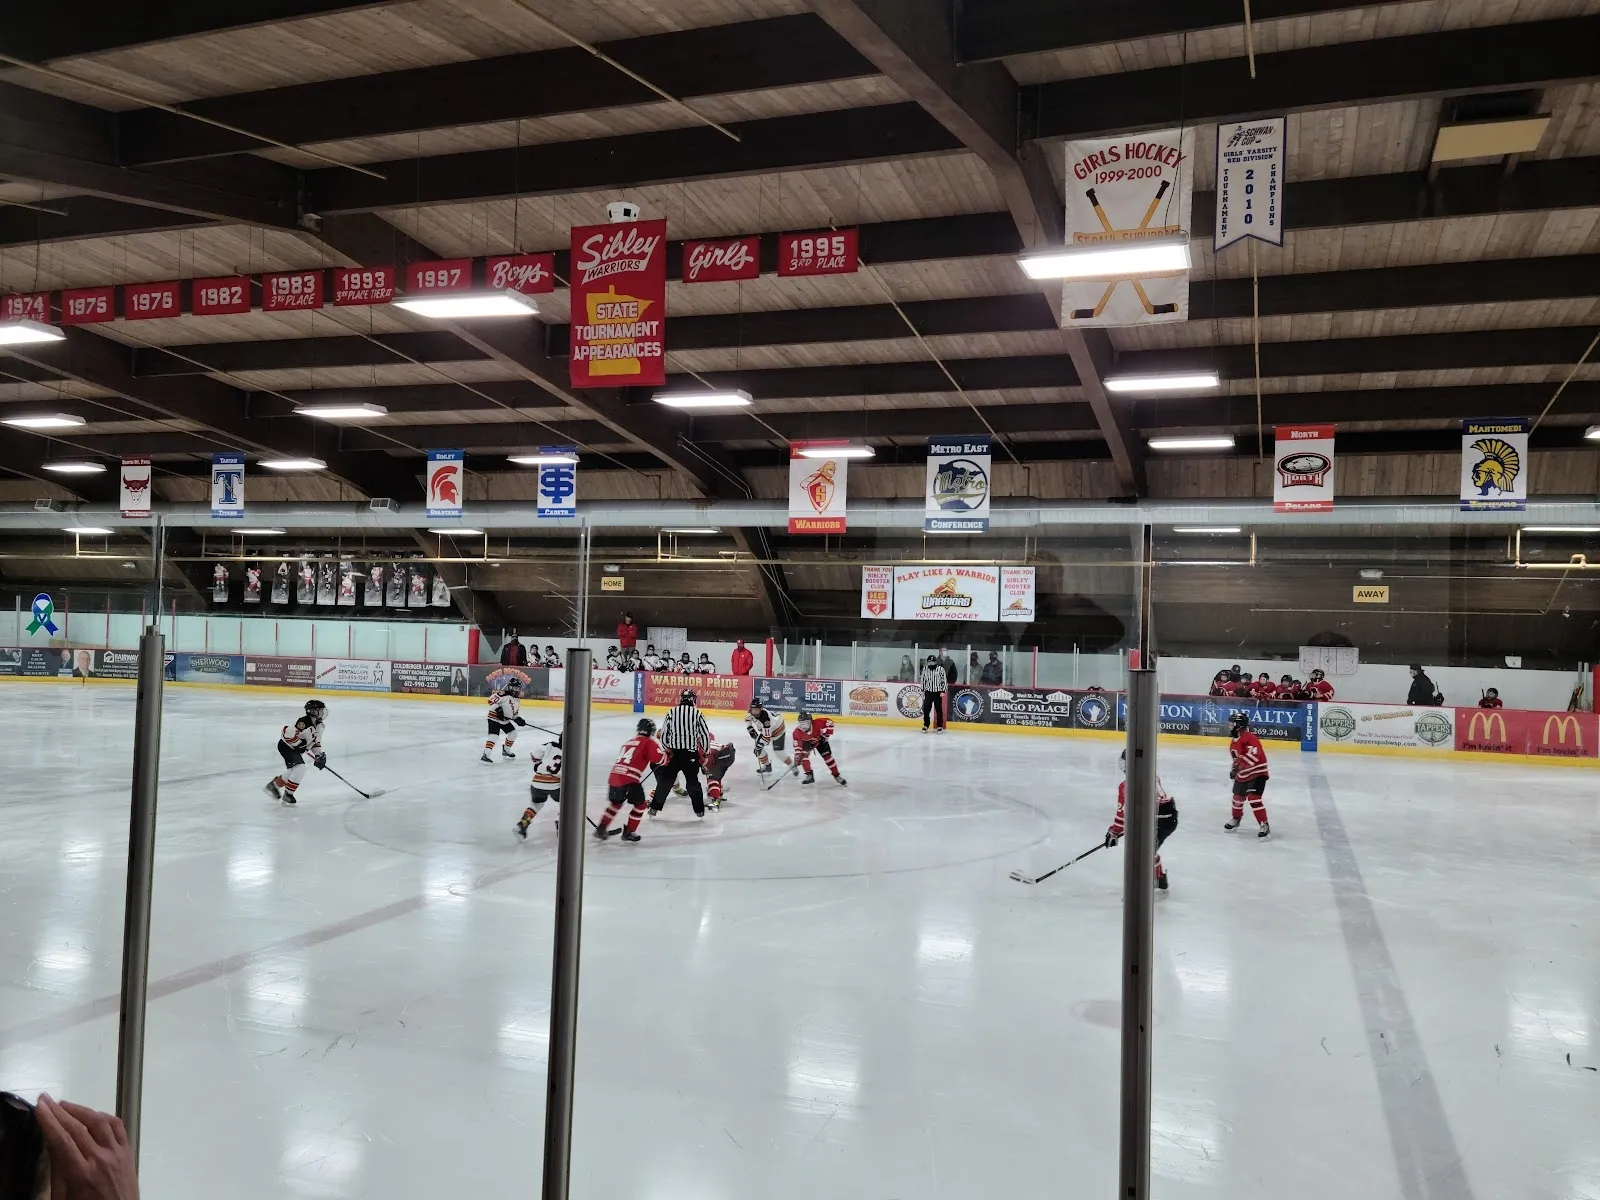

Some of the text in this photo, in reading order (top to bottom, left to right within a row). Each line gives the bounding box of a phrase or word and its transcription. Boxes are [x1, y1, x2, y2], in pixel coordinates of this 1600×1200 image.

[1243, 154, 1273, 162] DIVISION
[1247, 146, 1278, 155] VARSITY
[1073, 142, 1187, 181] GIRLS HOCKEY
[1095, 165, 1162, 185] 1999-2000
[1244, 169, 1254, 225] 2010
[1269, 163, 1277, 226] CHAMPIONS
[1221, 169, 1229, 238] TOURNAMENT
[577, 228, 661, 270] Sibley
[790, 236, 845, 259] 1995
[689, 241, 754, 280] Girls
[816, 255, 847, 269] PLACE
[416, 268, 461, 288] 1997
[492, 260, 549, 290] Boys
[588, 260, 641, 280] WARRIORS
[271, 275, 315, 295] 1983
[342, 271, 385, 291] 1993
[132, 292, 173, 312] 1976
[200, 286, 242, 306] 1982
[285, 293, 316, 306] PLACE
[8, 296, 44, 316] 1974
[69, 296, 107, 316] 1975
[596, 301, 638, 319] STATE
[575, 321, 659, 340] TOURNAMENT
[573, 342, 661, 361] APPEARANCES
[1291, 430, 1319, 439] NORTH
[1469, 424, 1522, 433] MAHTOMEDI
[931, 443, 989, 454] METRO EAST
[794, 520, 840, 529] WARRIORS
[931, 520, 984, 529] CONFERENCE
[897, 568, 997, 584] PLAY LIKE A WARRIOR
[922, 596, 971, 608] WARRIORS
[1357, 590, 1385, 598] AWAY
[114, 653, 139, 661] FAIRWAY
[191, 658, 230, 669] SHERWOOD
[651, 674, 739, 689] WARRIOR PRIDE
[654, 687, 677, 695] SKATE
[704, 689, 739, 699] WARRIOR
[804, 693, 836, 702] SOUTH
[654, 696, 674, 704] PLAY
[700, 699, 735, 708] WARRIOR
[993, 702, 1068, 713] BINGO PALACE
[1306, 703, 1314, 741] SIBLEY
[1321, 718, 1354, 729] TAPPERS
[1416, 723, 1450, 734] TAPPERS
